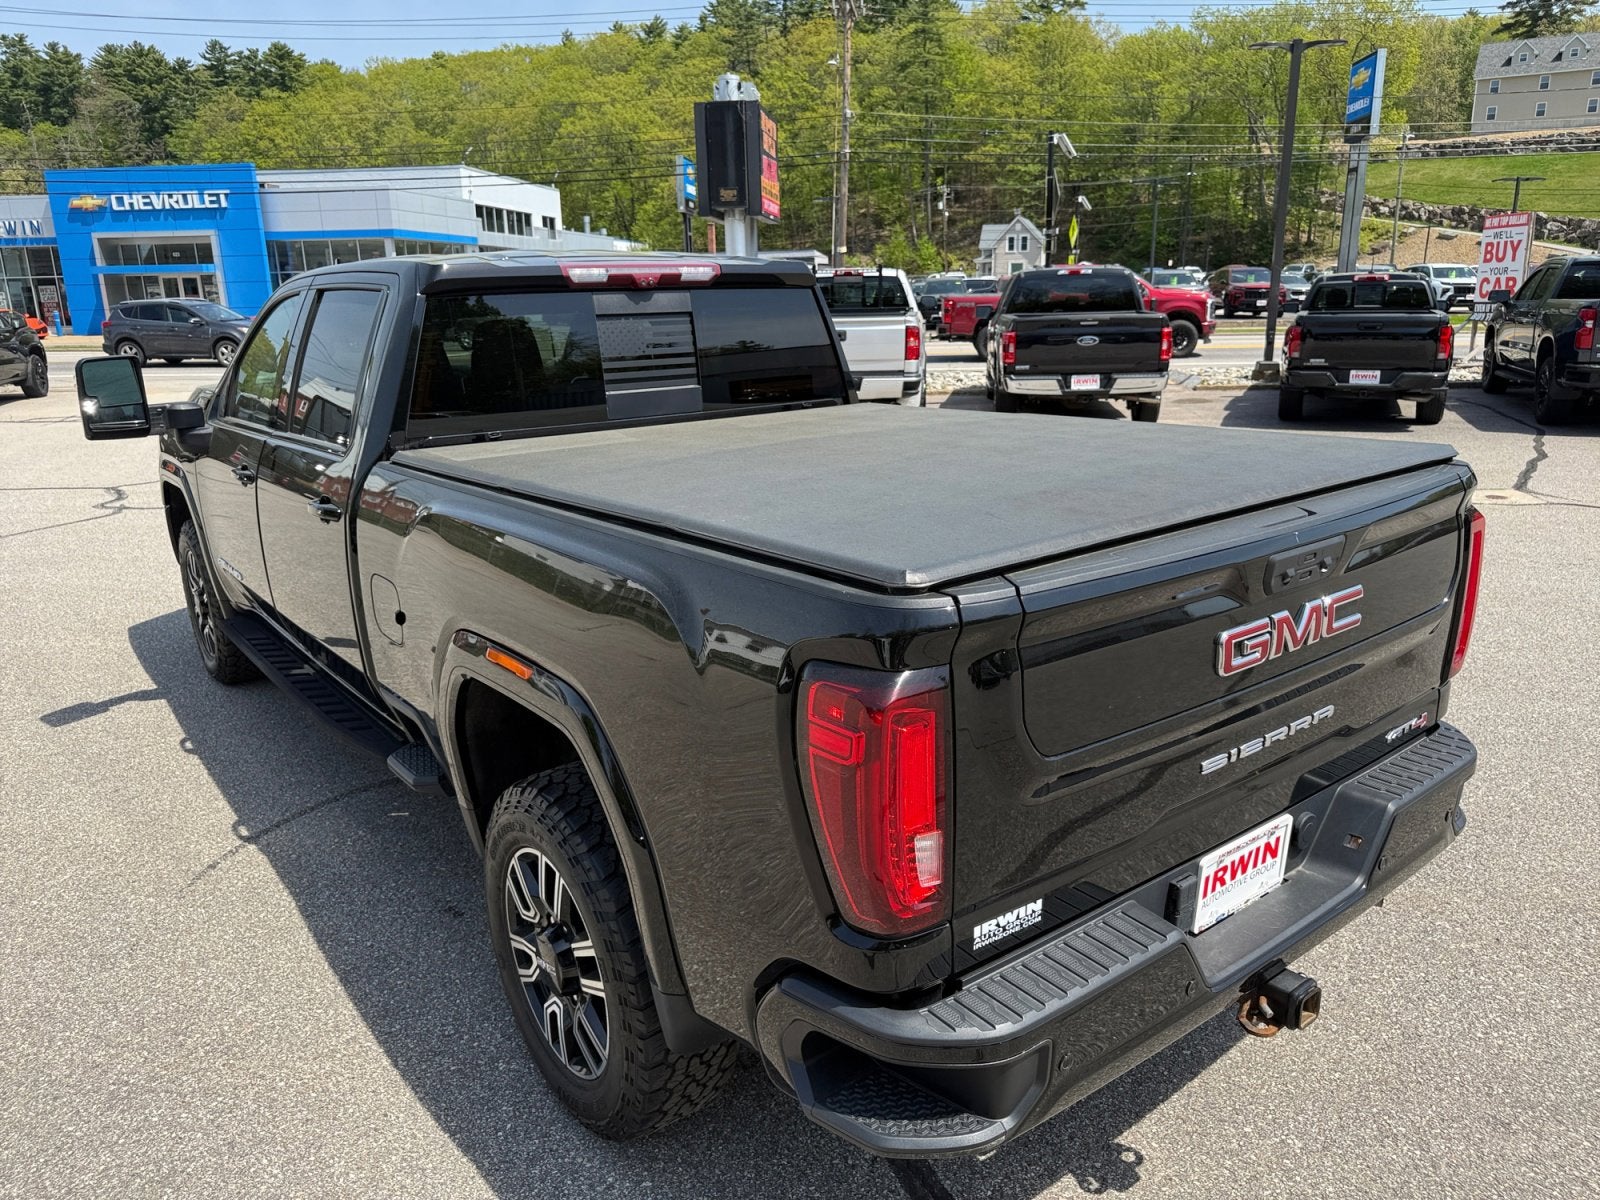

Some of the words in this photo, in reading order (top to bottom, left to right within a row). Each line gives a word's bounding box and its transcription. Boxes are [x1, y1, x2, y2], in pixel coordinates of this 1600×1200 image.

[111, 190, 230, 210] CHEVROLET
[0, 220, 41, 236] WIN
[1493, 230, 1514, 240] WE'LL
[1483, 240, 1522, 263] BUY
[1479, 277, 1517, 298] CAR
[1489, 267, 1508, 276] YOUR
[1214, 584, 1364, 677] GMC
[1200, 704, 1335, 775] SIERRA
[1202, 836, 1281, 900] IRWIN
[1201, 875, 1249, 910] AUTOMOTIVE
[1249, 861, 1277, 880] GROUP
[973, 898, 1043, 939] IRWIN
[973, 915, 1041, 950] IRWINZONE.COM
[974, 927, 1003, 944] AUTO
[1005, 910, 1042, 930] GROUP
